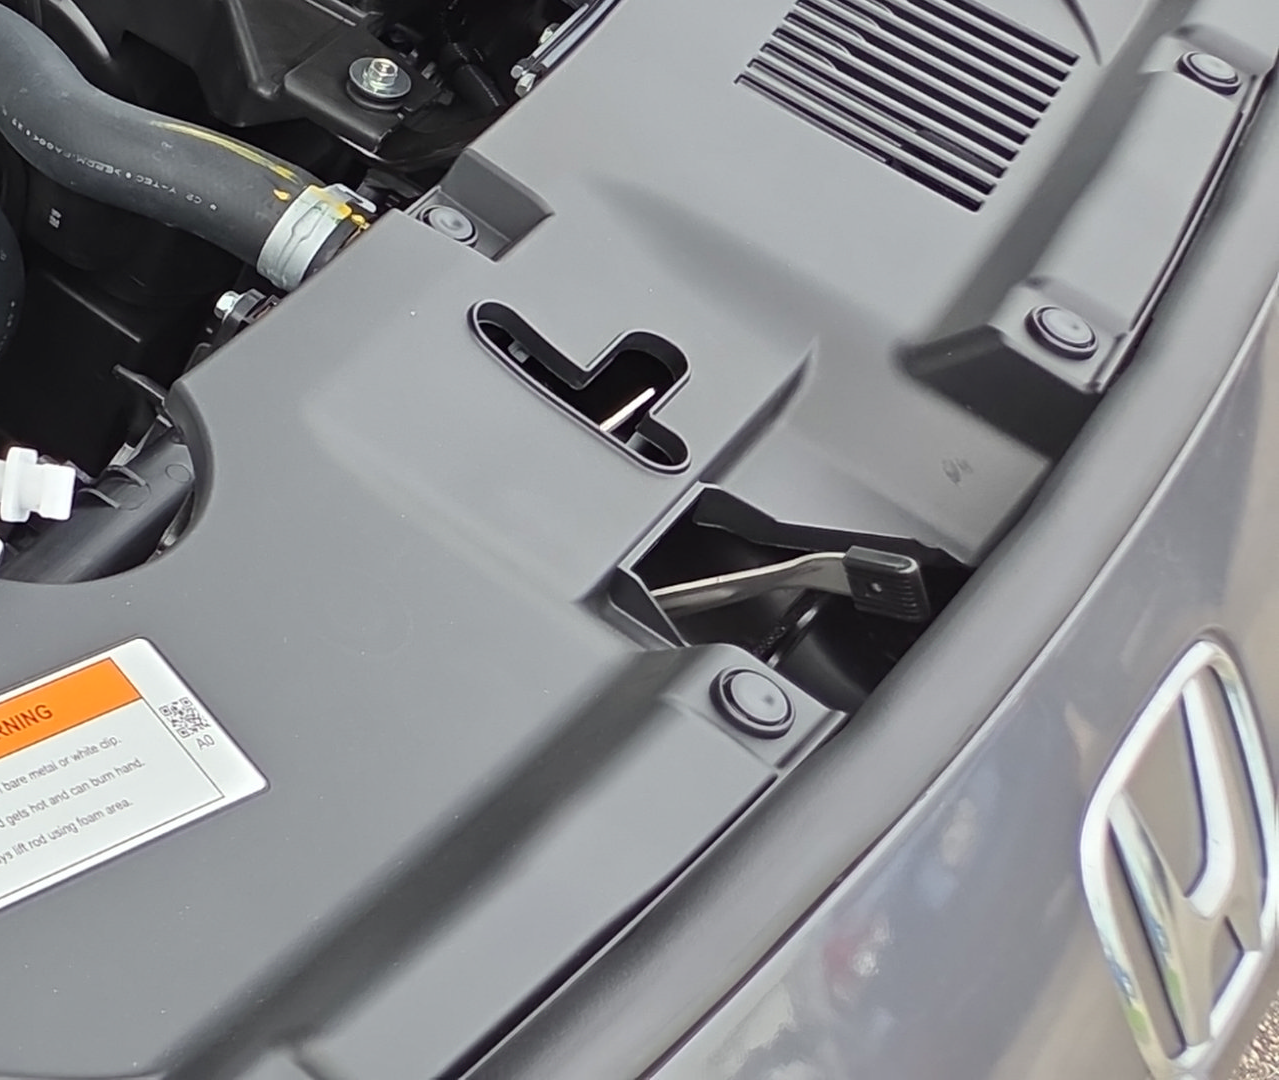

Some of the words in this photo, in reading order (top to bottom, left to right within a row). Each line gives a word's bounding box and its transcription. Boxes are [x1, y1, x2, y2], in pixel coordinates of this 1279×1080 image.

[1, 776, 28, 791] bare
[28, 760, 59, 780] metal
[58, 756, 70, 768] or
[71, 744, 99, 762] white
[99, 735, 123, 750] clip.
[5, 807, 30, 826] gets
[29, 800, 48, 814] hot
[49, 790, 70, 806] and
[70, 783, 90, 796] can
[89, 772, 115, 787] burn
[114, 757, 145, 777] hand.
[11, 841, 30, 856] lift
[28, 834, 48, 850] rod
[48, 820, 79, 841] using
[75, 810, 105, 827] foam
[106, 798, 134, 815] area.
